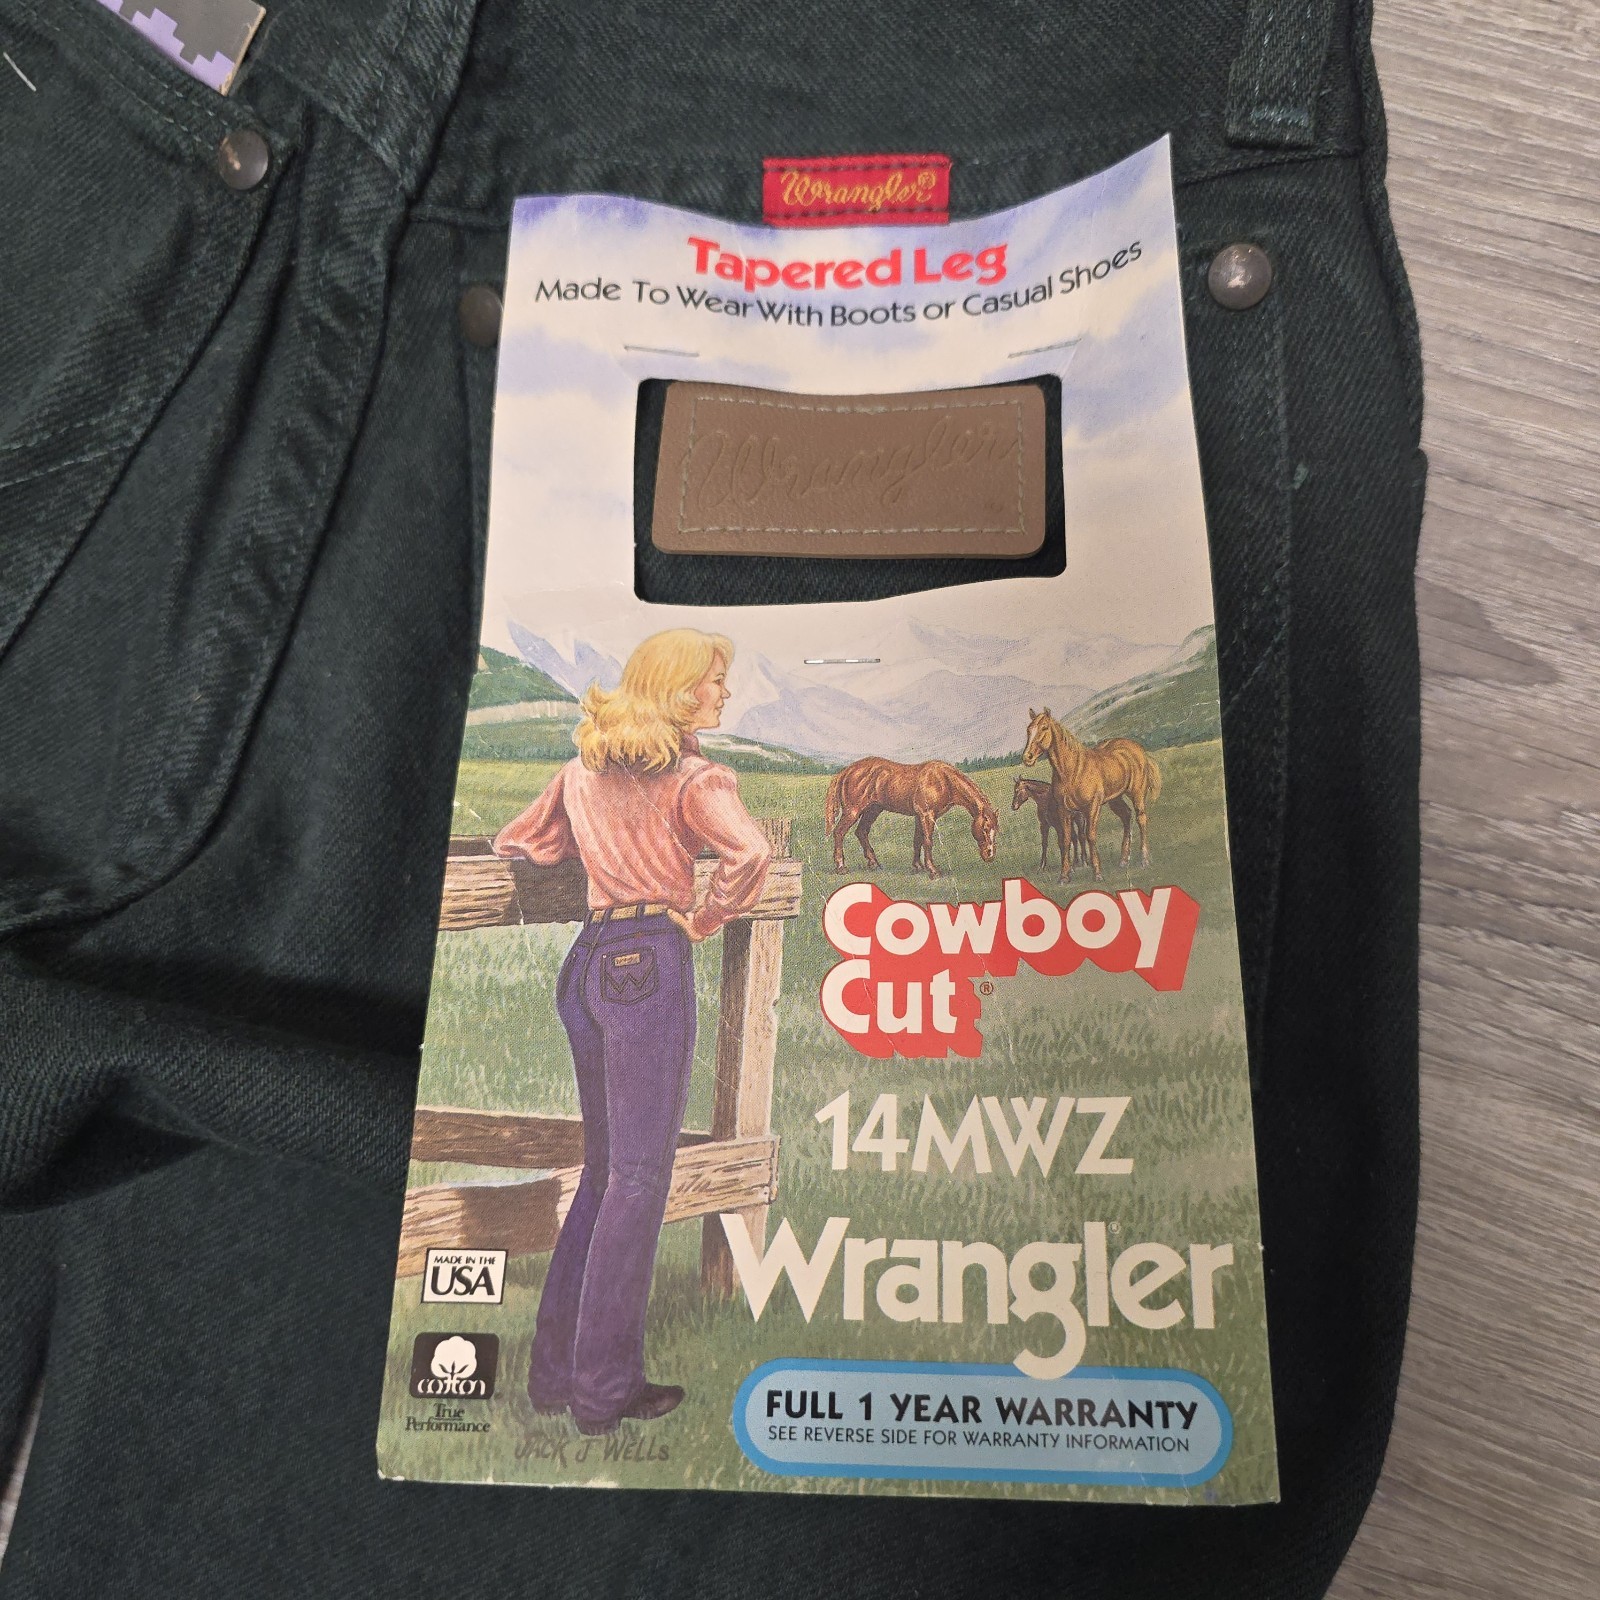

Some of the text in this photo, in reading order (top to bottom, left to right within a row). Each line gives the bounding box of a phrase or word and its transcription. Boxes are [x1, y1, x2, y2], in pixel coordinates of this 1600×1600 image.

[687, 236, 1008, 293] Tapered Leg
[534, 240, 1143, 327] Made To Wear With Boots or Casual Shoes
[822, 878, 1175, 968] Cowboy
[815, 1091, 1133, 1178] 14MWZ
[433, 1255, 496, 1265] MADE IN THE
[430, 1265, 496, 1296] USA
[417, 1377, 486, 1396] cotton
[405, 1416, 491, 1433] Performance
[433, 1402, 465, 1418] True
[766, 1389, 1198, 1430] FULL 1 YEAR WARRANTY
[768, 1425, 1189, 1452] SEE REVERSE SIDE FOR WARRANTY INFORMATION
